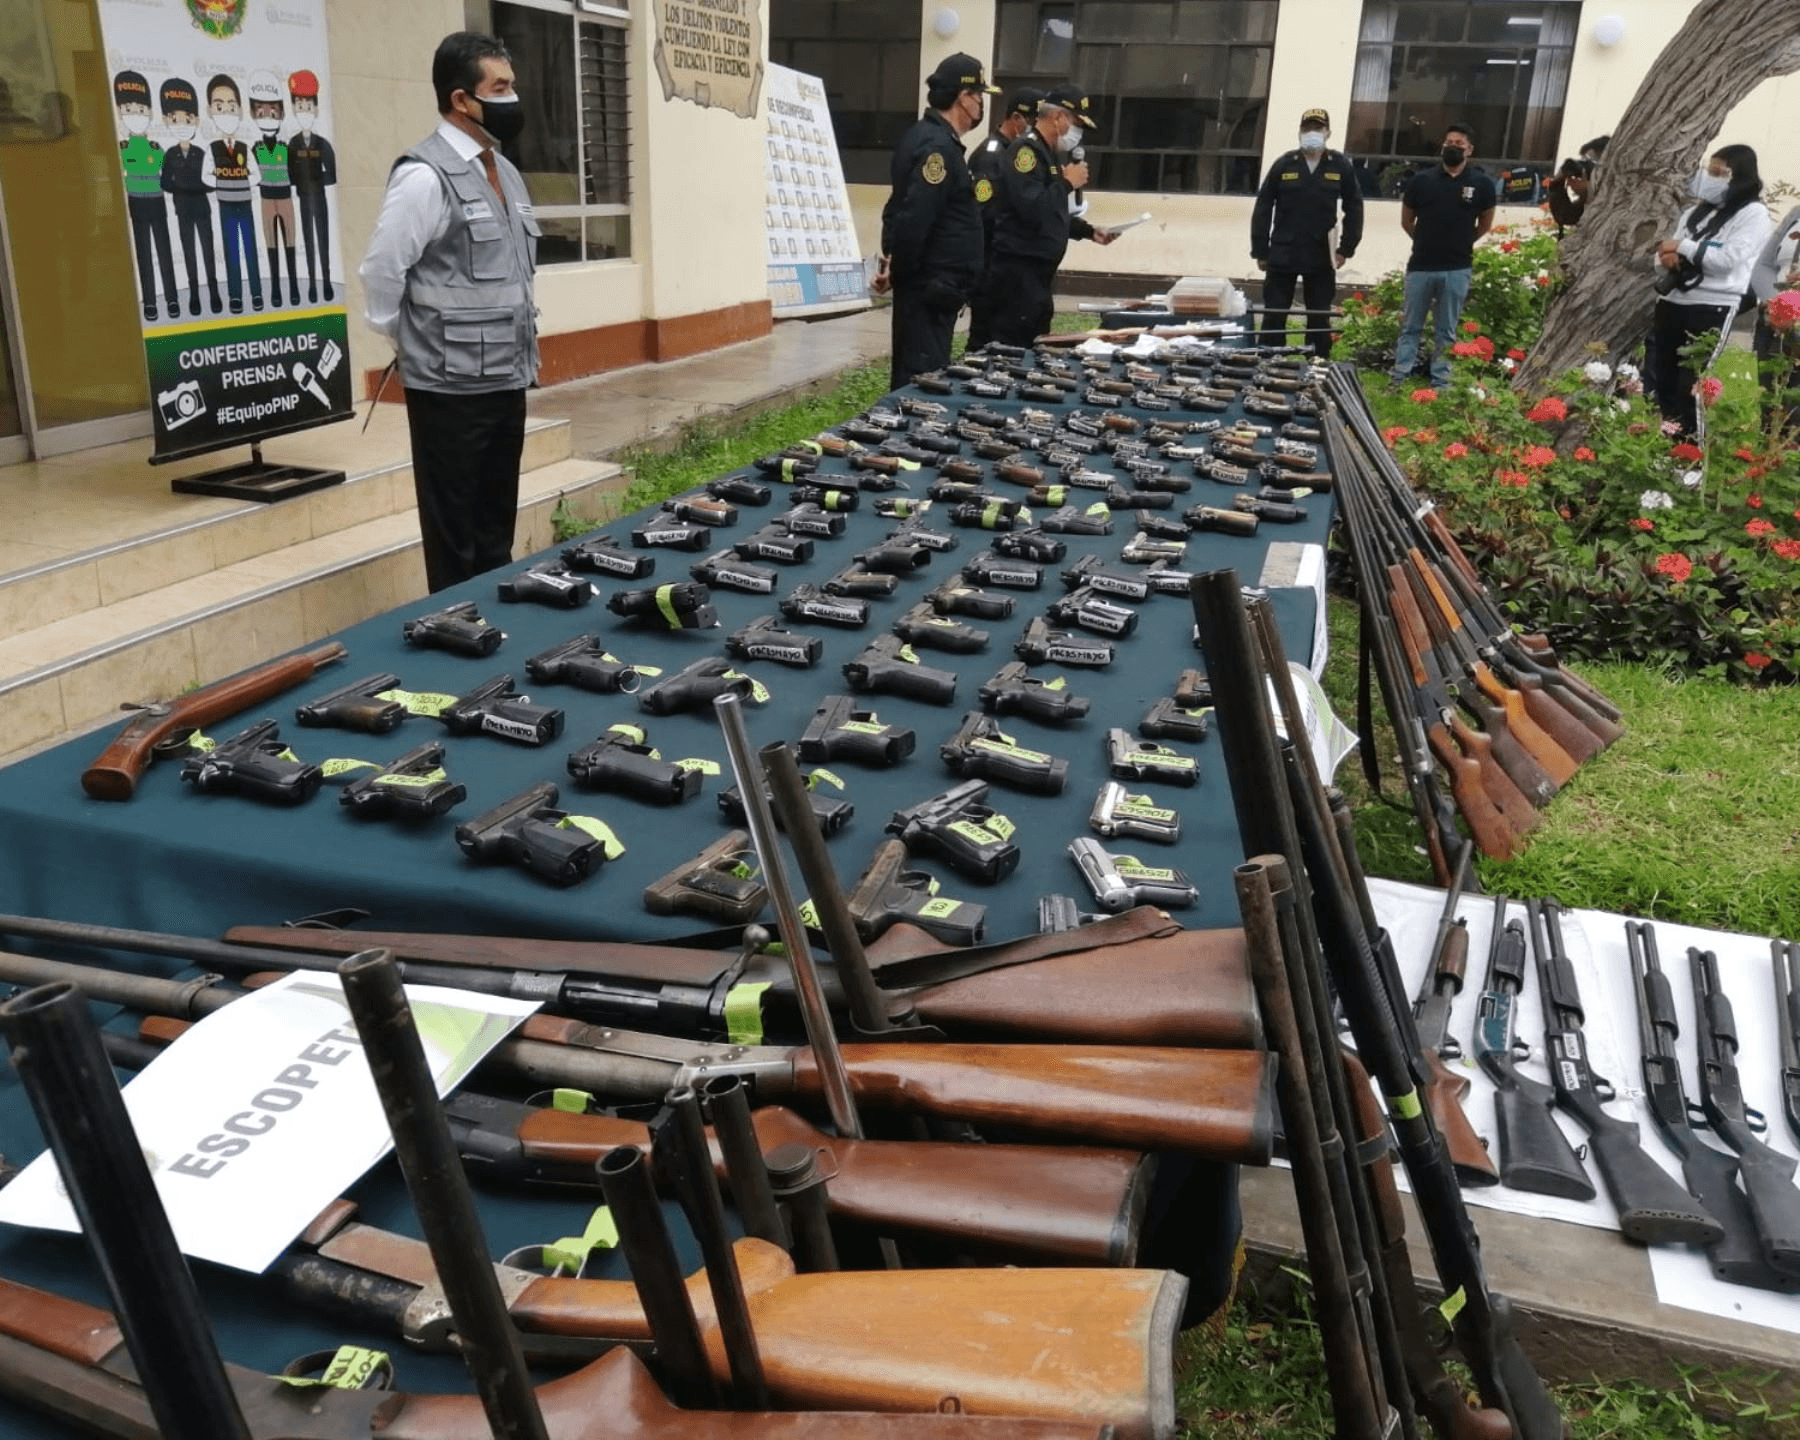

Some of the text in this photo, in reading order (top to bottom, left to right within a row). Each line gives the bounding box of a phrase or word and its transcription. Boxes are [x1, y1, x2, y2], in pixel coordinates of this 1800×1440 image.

[665, 3, 750, 38] LOS DELITOS VIOLENTOS
[664, 25, 710, 52] CUMPLIENDO
[712, 34, 721, 54] LA
[674, 49, 706, 72] EFICACIA
[714, 56, 750, 78] EFICIENCIA
[179, 333, 318, 370] CONFERENCIA DE
[222, 362, 287, 390] PRENSA
[216, 394, 300, 425] #EquipoPNP
[1050, 650, 1106, 662] PACASMAYO
[168, 1018, 365, 1180] ESCOPET
